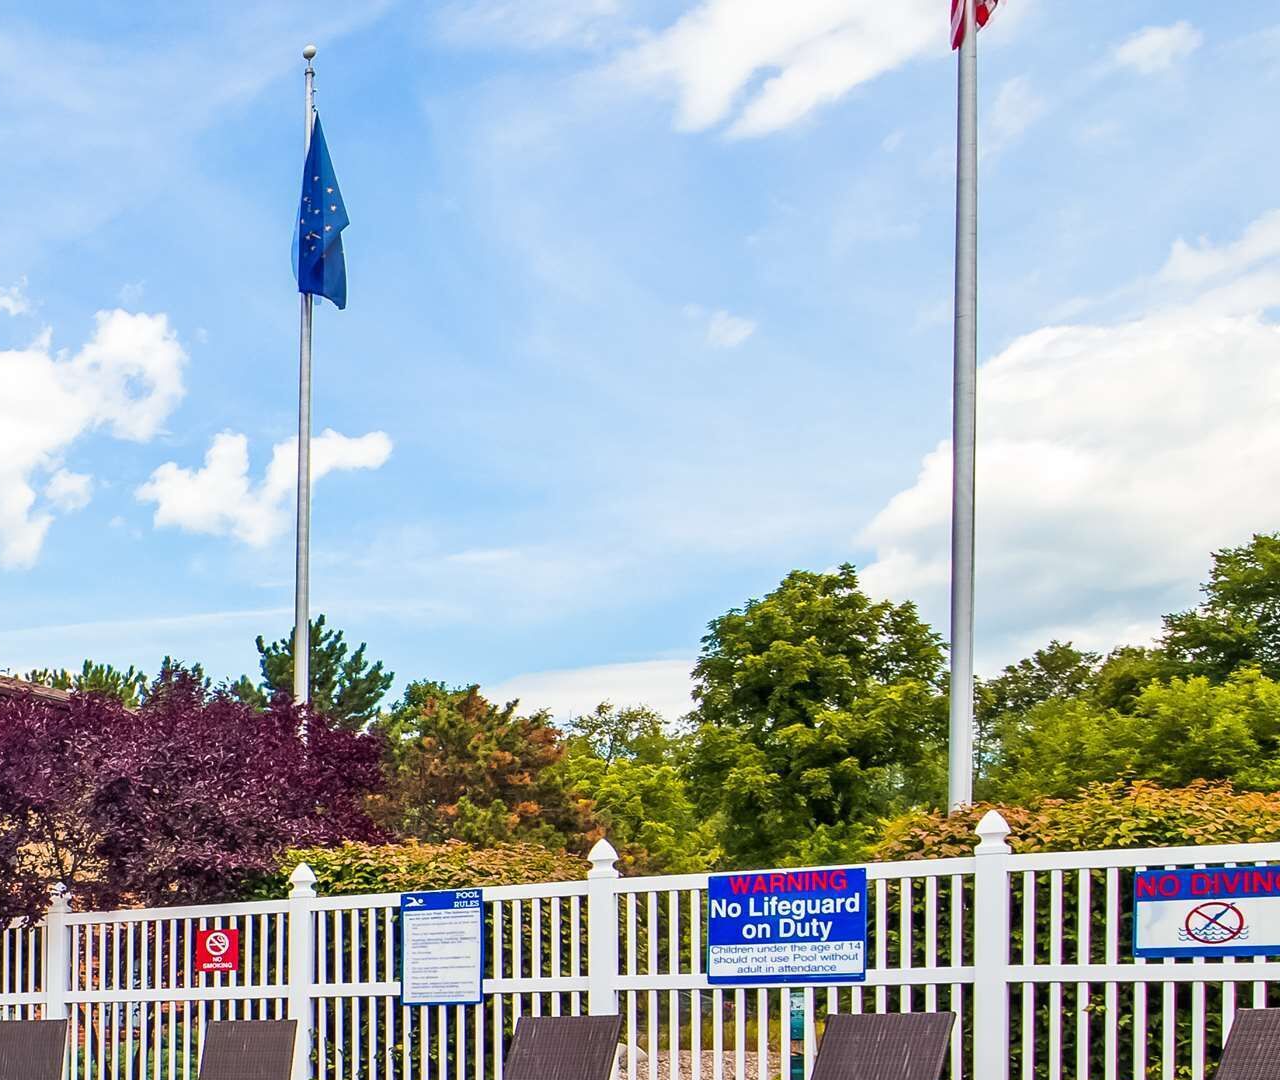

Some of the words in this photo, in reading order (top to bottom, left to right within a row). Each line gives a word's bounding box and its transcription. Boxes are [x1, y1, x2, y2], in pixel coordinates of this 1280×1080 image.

[728, 869, 848, 894] WARNING
[1136, 874, 1181, 897] NO
[1190, 870, 1280, 896] DIVIN
[455, 891, 480, 899] POOL
[453, 900, 480, 908] RULES
[711, 899, 742, 918] No
[749, 892, 860, 920] Lifeguard
[742, 923, 771, 939] on
[779, 918, 833, 942] Duty
[711, 945, 754, 954] Children
[757, 944, 787, 953] under
[790, 944, 807, 952] the
[810, 944, 831, 953] age
[834, 942, 844, 951] of
[849, 942, 861, 950] 14
[714, 955, 748, 964] should
[751, 955, 767, 963] not
[771, 955, 790, 963] use
[793, 953, 817, 962] Pool
[820, 952, 859, 961] without
[737, 965, 762, 974] adult
[766, 965, 775, 973] in
[778, 964, 837, 973] attendance
